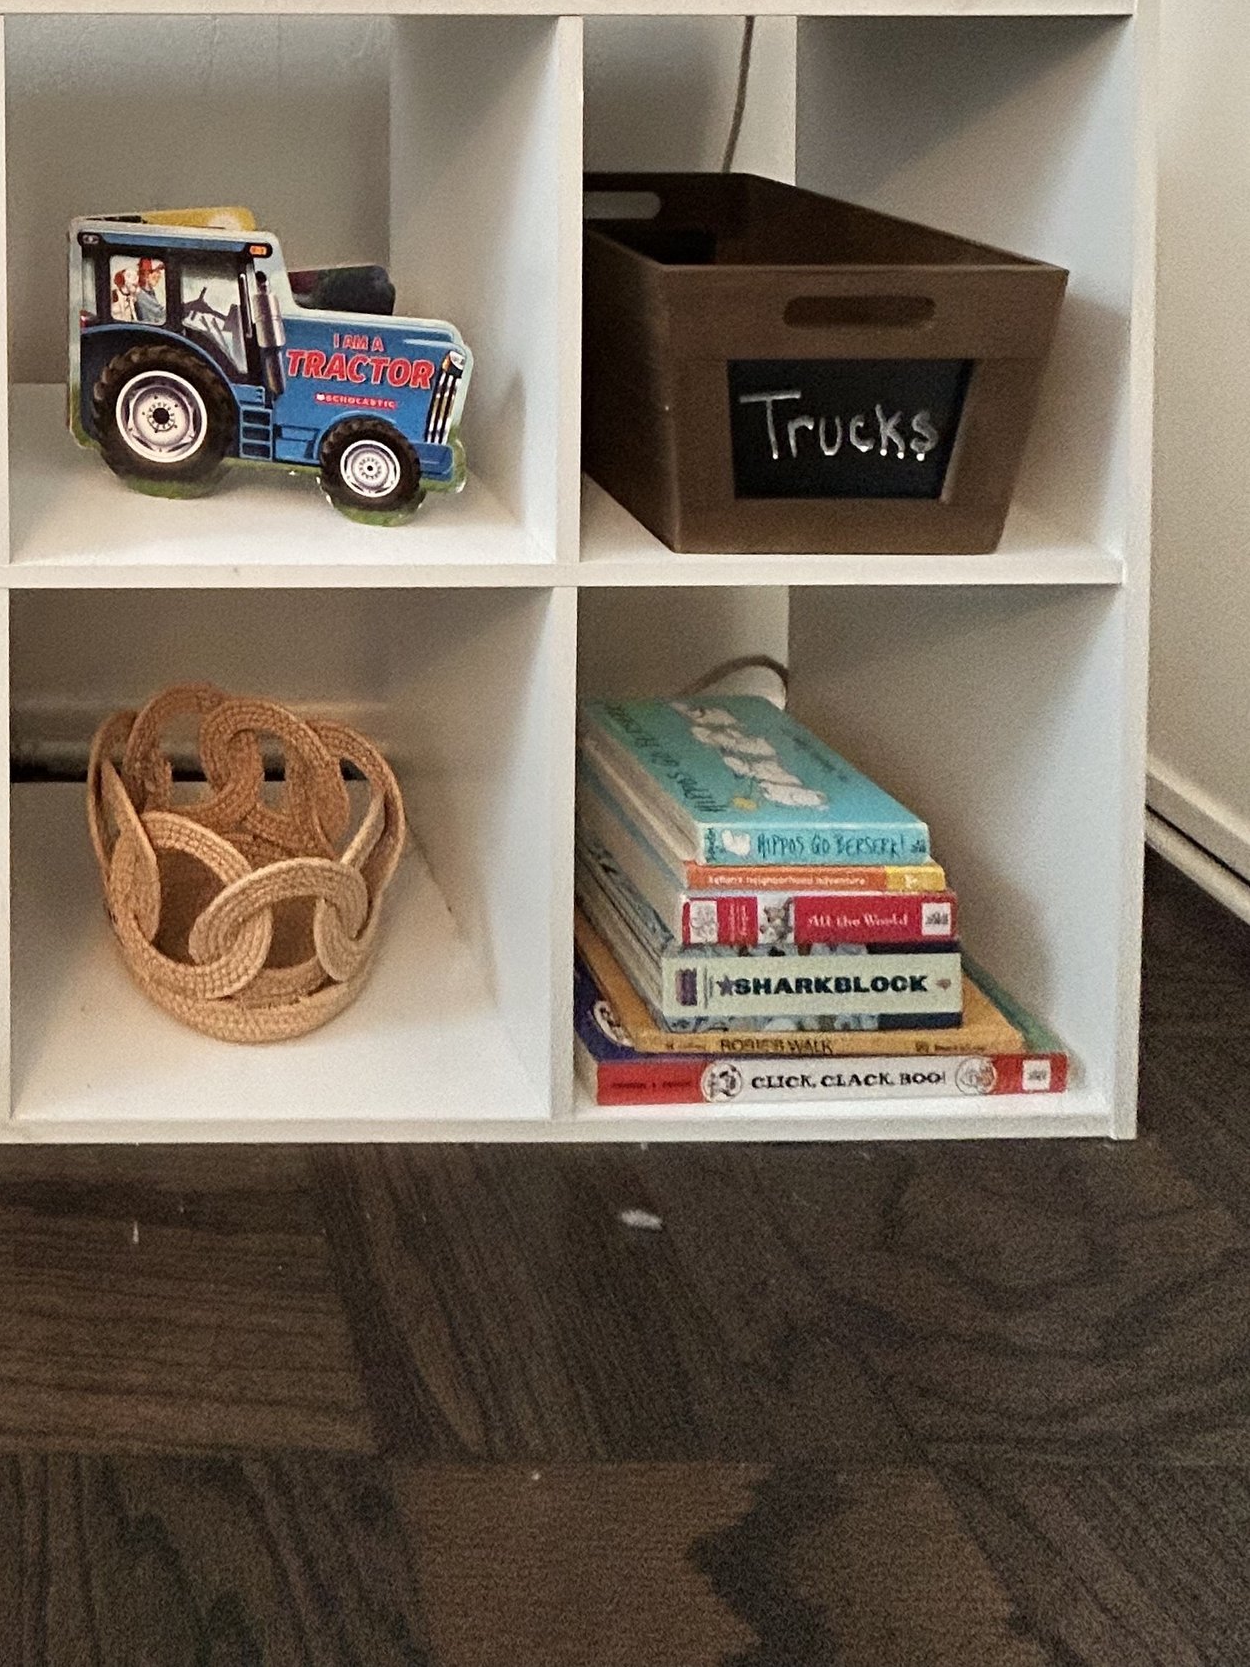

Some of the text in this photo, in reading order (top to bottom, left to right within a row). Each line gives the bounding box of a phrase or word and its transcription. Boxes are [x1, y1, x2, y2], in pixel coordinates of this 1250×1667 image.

[333, 333, 385, 352] I AM A
[286, 349, 435, 389] TRACTOR
[325, 395, 396, 409] SCHOLASTIC
[738, 389, 940, 462] Trucks
[756, 832, 805, 860] HIPPOS
[812, 832, 831, 855] GO
[808, 911, 833, 927] All
[734, 974, 929, 996] SHARKBLOCK
[899, 1070, 947, 1086] BOO!
